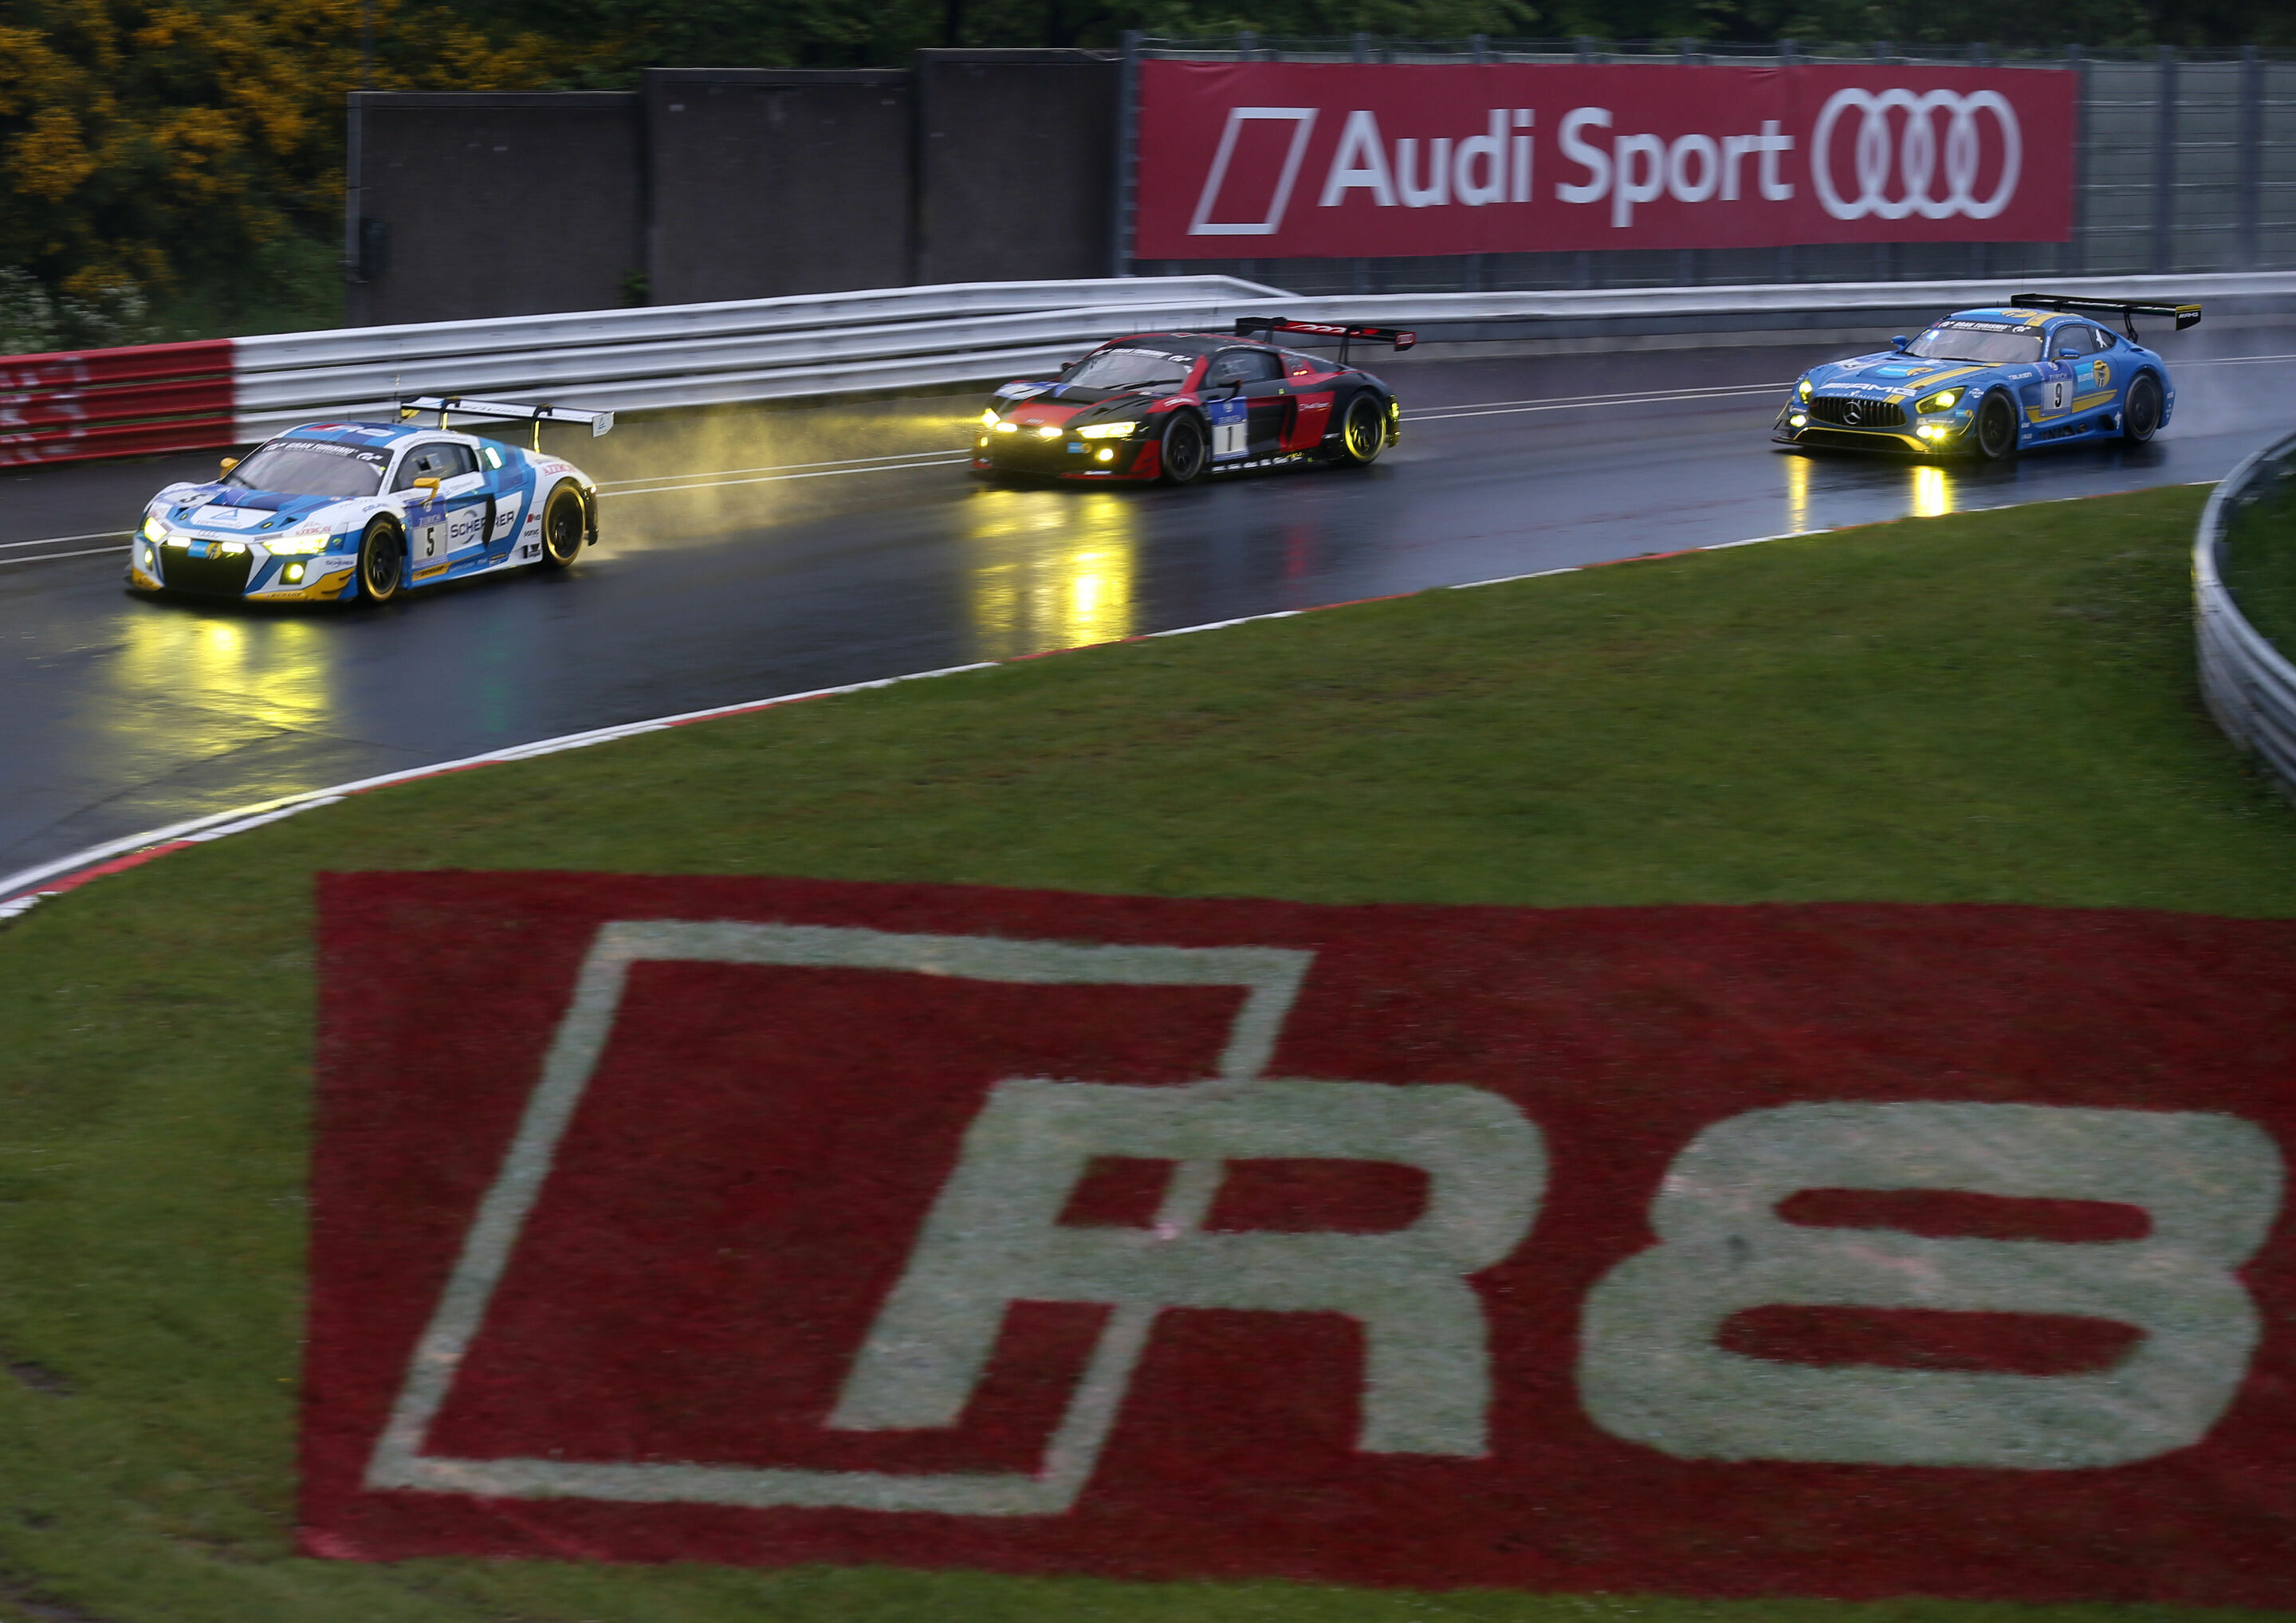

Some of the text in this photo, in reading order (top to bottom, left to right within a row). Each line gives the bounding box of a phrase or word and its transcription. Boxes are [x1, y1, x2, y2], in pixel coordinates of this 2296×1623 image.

[1318, 106, 1795, 229] Audi Sport
[1848, 383, 1917, 397] AMG
[2054, 383, 2062, 407] 9
[1226, 426, 1233, 452] 1
[426, 526, 434, 556] 5
[823, 1076, 2286, 1473] R8
